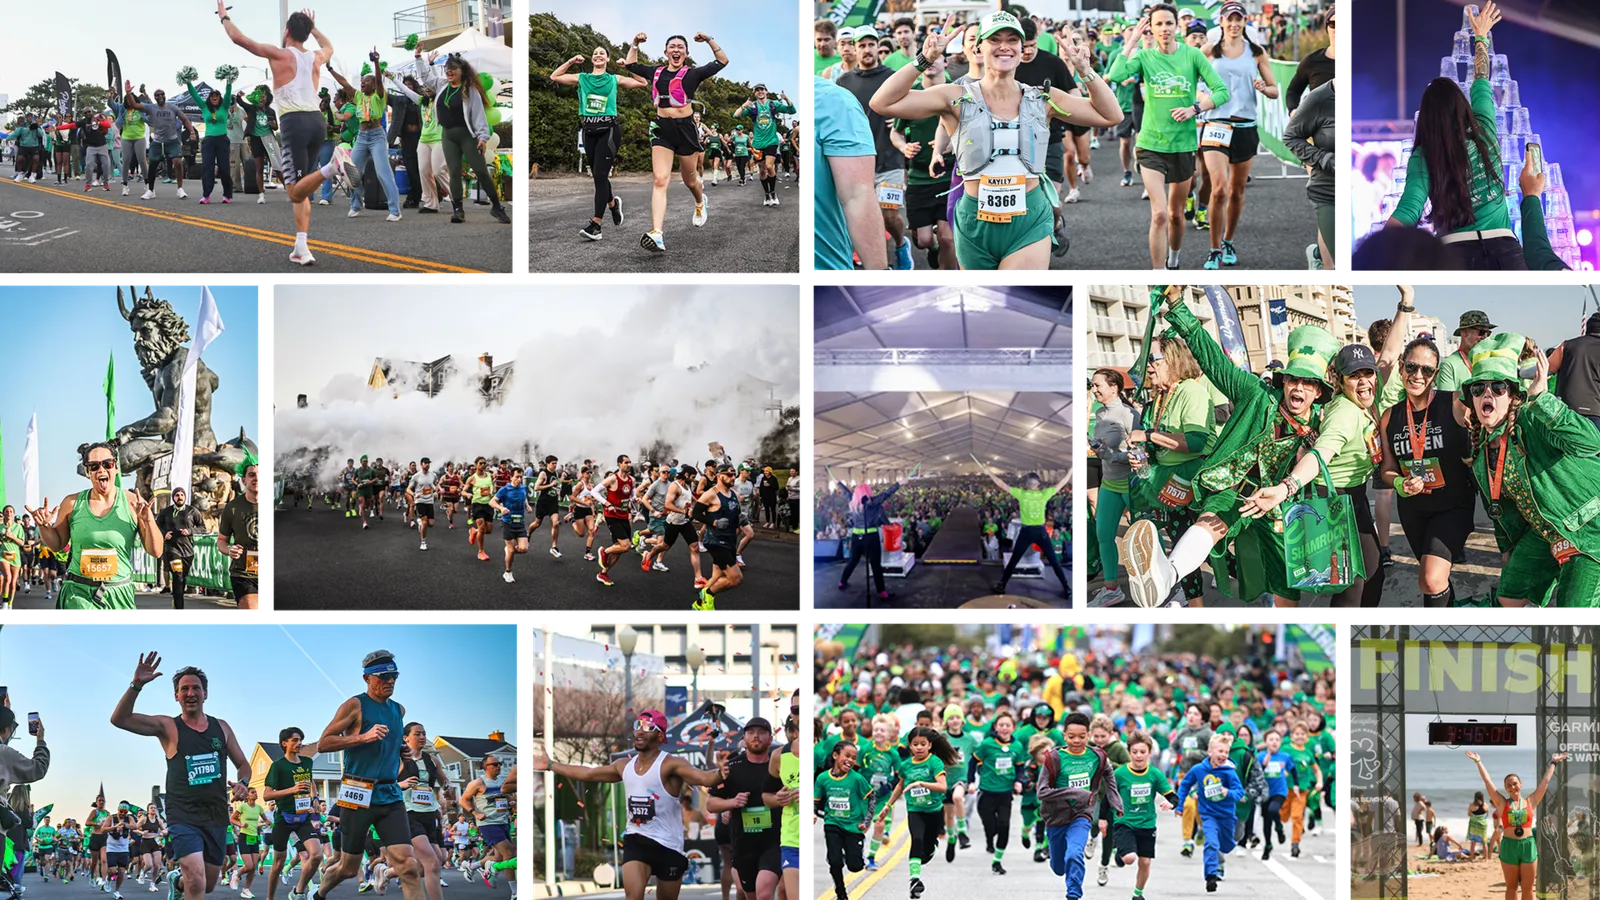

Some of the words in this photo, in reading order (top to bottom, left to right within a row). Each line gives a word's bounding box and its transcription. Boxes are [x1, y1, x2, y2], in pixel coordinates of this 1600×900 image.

[887, 193, 900, 201] 5712
[988, 195, 1016, 207] 8368
[1394, 434, 1444, 456] EILEN
[1165, 485, 1186, 500] 17579
[1291, 525, 1345, 560] SHAMROCK
[86, 564, 112, 572] 15657
[1360, 639, 1593, 694] FINISH
[194, 765, 215, 775] 11790
[344, 790, 363, 802] 4469
[632, 807, 648, 815] 3572
